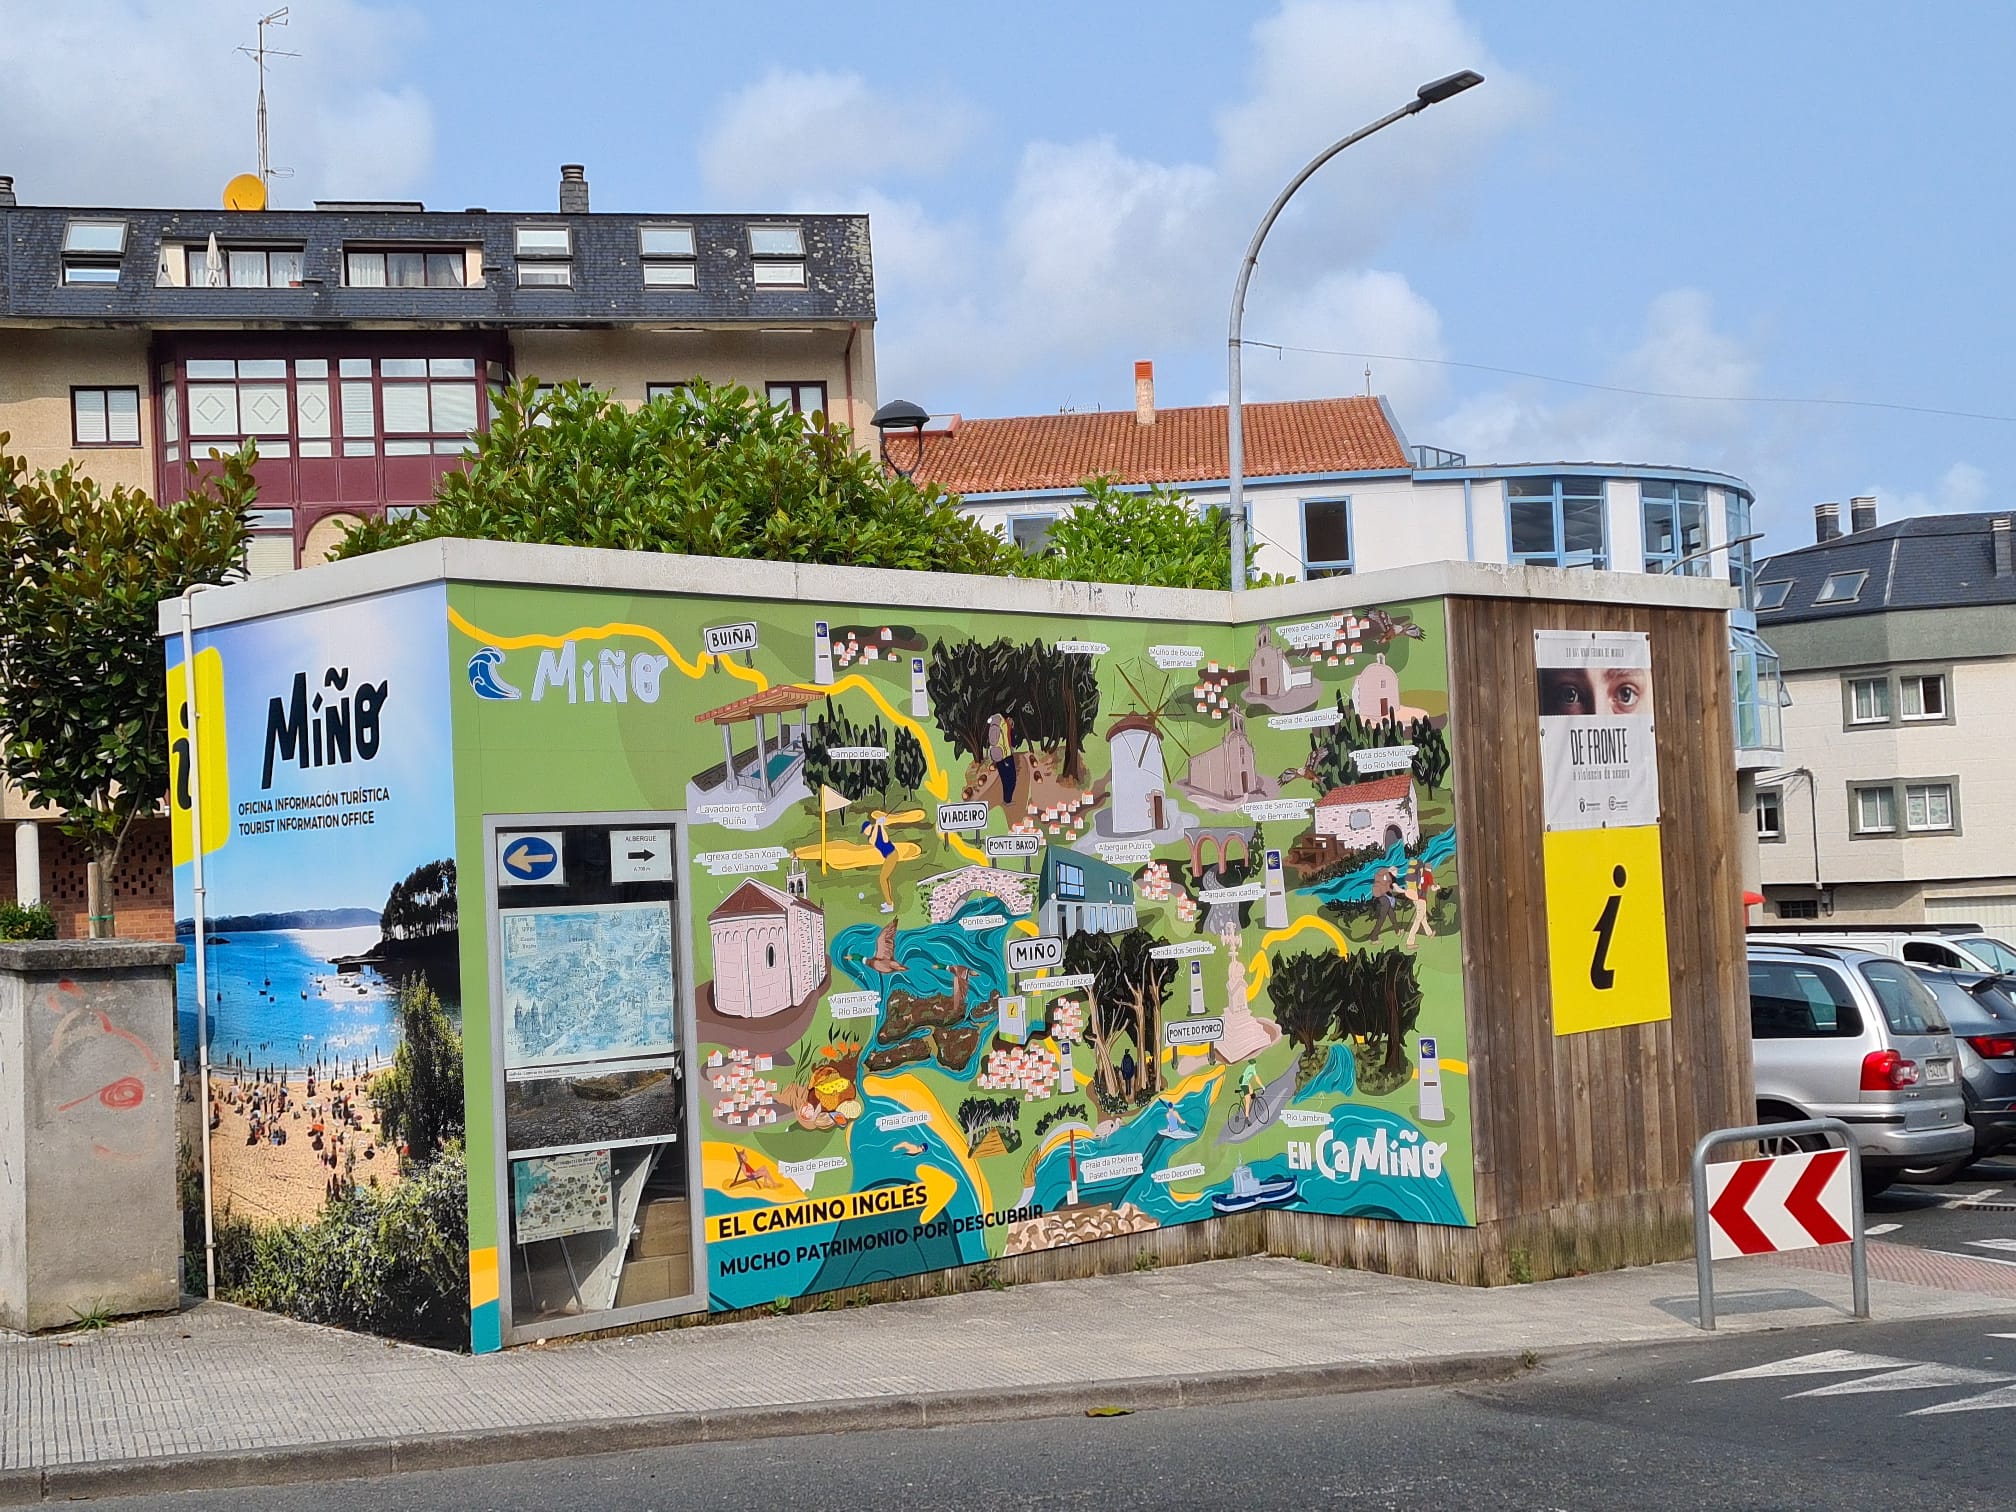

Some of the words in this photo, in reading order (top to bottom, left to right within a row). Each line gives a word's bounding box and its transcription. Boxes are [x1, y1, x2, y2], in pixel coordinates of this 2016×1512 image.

[711, 628, 752, 647] BUIÑA
[1294, 715, 1302, 723] de
[830, 750, 858, 760] Campo
[859, 750, 869, 758] de
[1570, 729, 1584, 766] DE
[1588, 728, 1628, 765] FRONTE
[238, 796, 273, 816] OFICINA
[275, 790, 339, 812] INFORMACIÓN
[340, 786, 390, 805] TURÍSTICA
[700, 804, 740, 814] Lavadoiro
[742, 804, 766, 812] Fonte
[239, 818, 275, 836] TOURIST
[276, 814, 340, 832] INFORMATION
[341, 810, 375, 827] OFFICE
[941, 808, 985, 824] VIADEIRO
[989, 840, 1012, 850] PONTE
[1015, 840, 1036, 850] BAXOI
[704, 852, 730, 862] Igrexa
[732, 851, 742, 860] de
[744, 850, 760, 860] San
[722, 864, 732, 873] de
[734, 863, 768, 872] Vilanova
[1016, 943, 1056, 962] MIÑO
[1169, 1026, 1190, 1038] PONTE
[1191, 1026, 1200, 1036] DO
[1202, 1024, 1221, 1034] PORCO
[881, 1116, 900, 1128] Praia
[902, 1112, 928, 1125] Grande
[1287, 1140, 1313, 1170] EN
[785, 1164, 804, 1174] Praia
[806, 1162, 816, 1170] de
[718, 1216, 746, 1239] EL
[752, 1198, 846, 1233] CAMINO
[852, 1181, 928, 1218] INGLÉS
[719, 1249, 790, 1278] MUCHO
[796, 1227, 908, 1264] PATRIMONIO
[913, 1220, 949, 1241] POR
[952, 1203, 1044, 1235] DESCUBRIR
